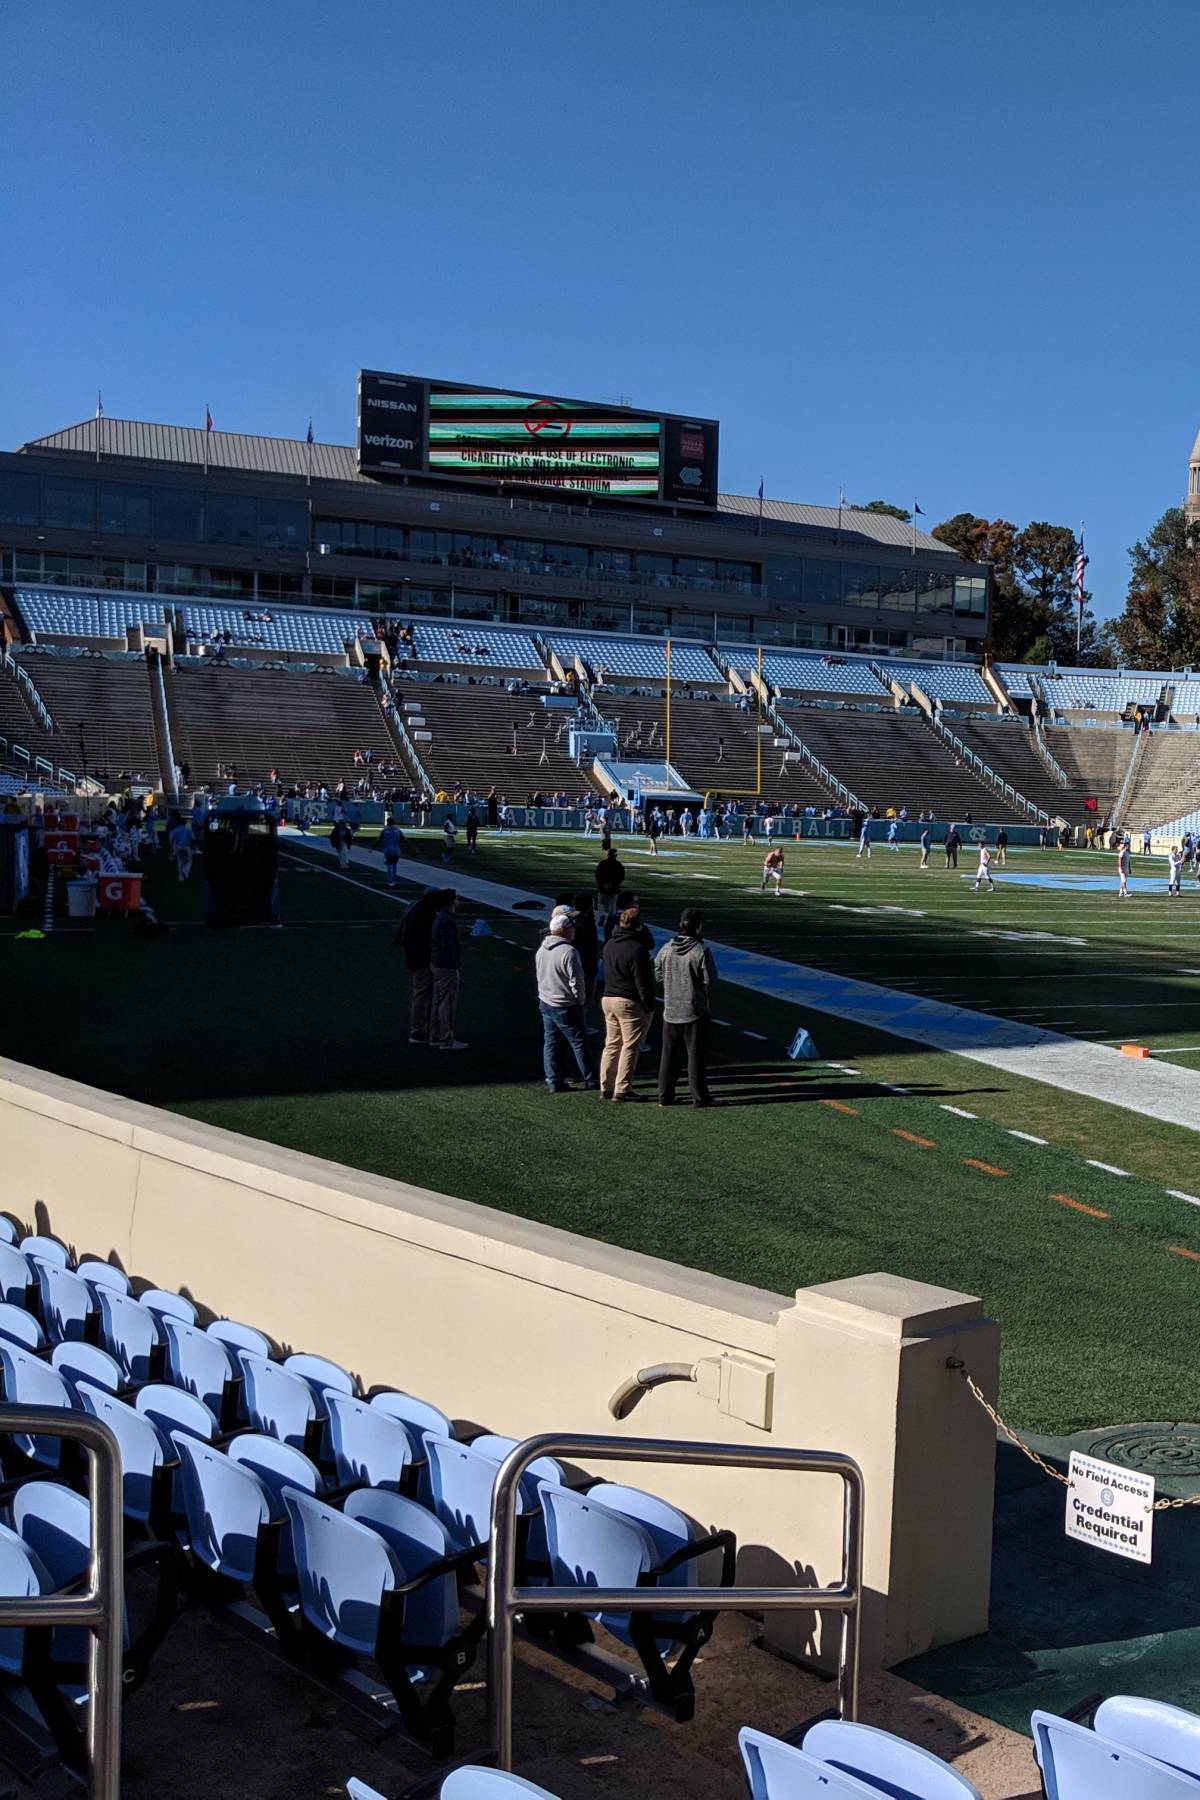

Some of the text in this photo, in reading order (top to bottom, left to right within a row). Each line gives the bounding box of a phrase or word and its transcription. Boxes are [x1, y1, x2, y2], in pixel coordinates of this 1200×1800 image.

[367, 398, 417, 413] NISSAN
[364, 434, 414, 450] verizon
[461, 449, 518, 468] CIGARETTES
[521, 457, 530, 469] IS
[547, 447, 563, 459] USE
[580, 449, 634, 469] ELECTRONIC
[569, 477, 611, 492] STADIUM
[506, 808, 625, 830] AROLIA
[105, 881, 123, 900] G
[1072, 1464, 1084, 1477] No
[1085, 1469, 1110, 1486] Field
[1110, 1478, 1149, 1499] Access
[1072, 1497, 1144, 1533] Credential
[1076, 1514, 1138, 1547] Required
